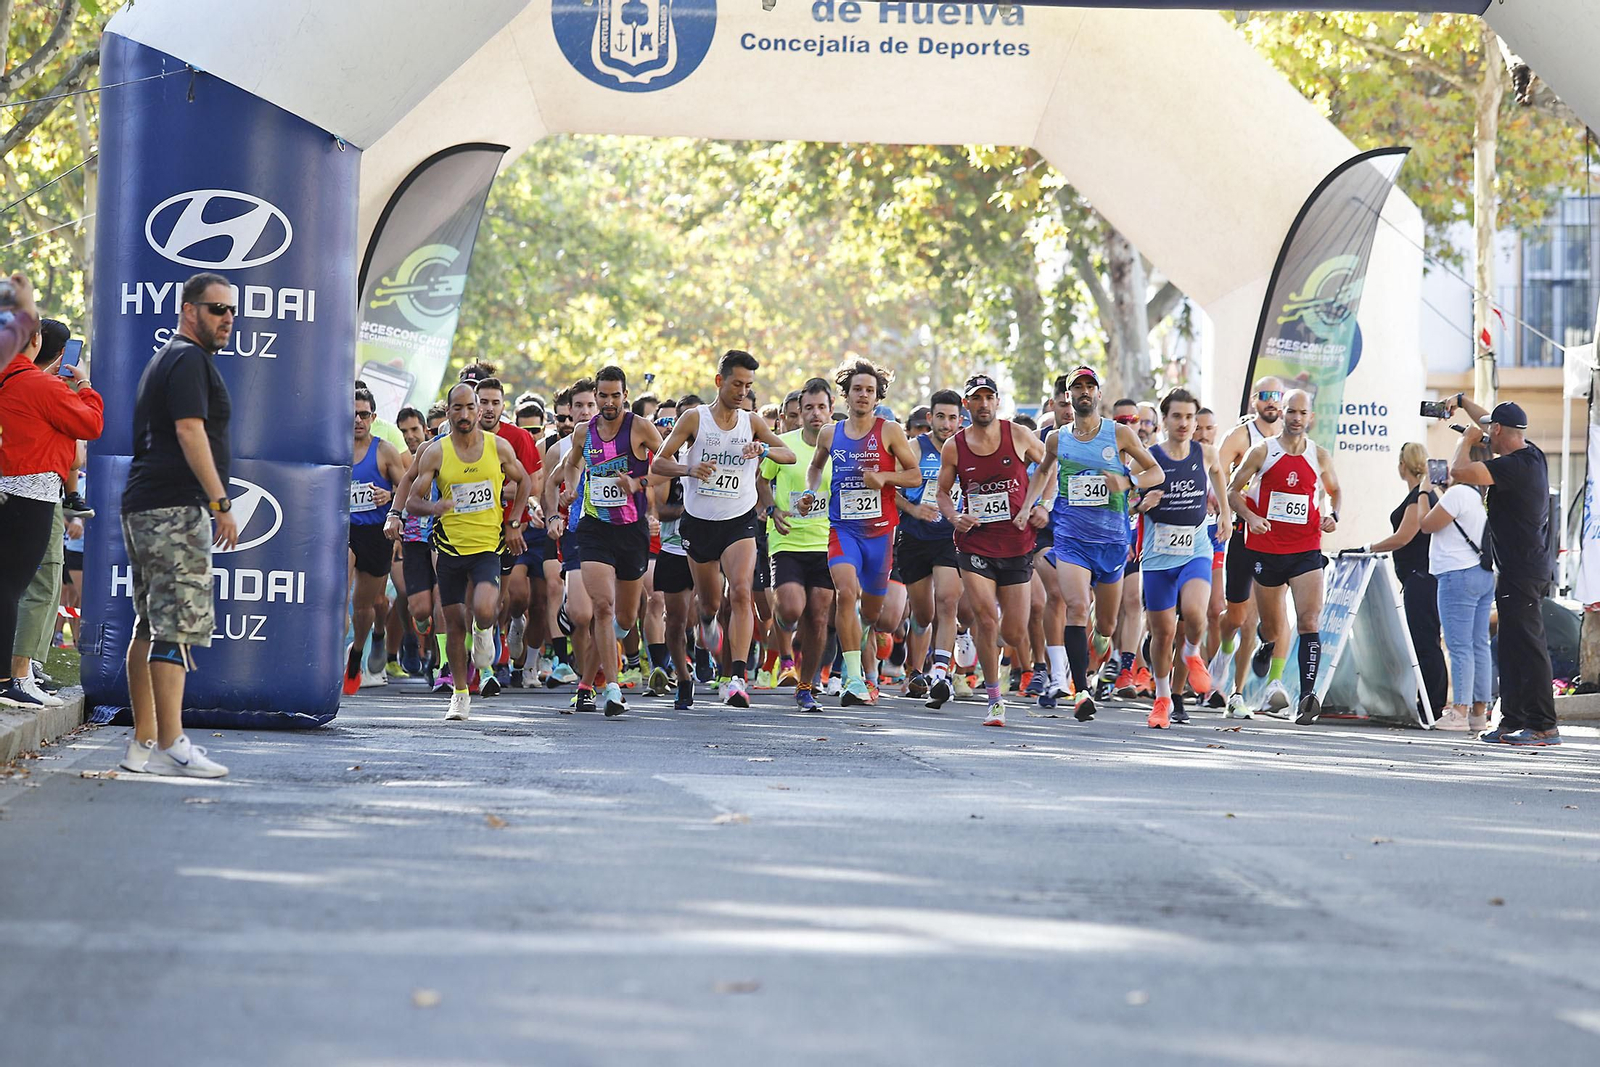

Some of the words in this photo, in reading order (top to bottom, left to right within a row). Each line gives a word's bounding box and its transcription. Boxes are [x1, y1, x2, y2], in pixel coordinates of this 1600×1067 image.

[812, 0, 862, 23] de
[878, 2, 1025, 25] Huelva
[740, 33, 870, 56] Concejalía
[880, 36, 909, 54] de
[918, 37, 1030, 59] Deportes
[121, 282, 315, 322] HYDAI
[1339, 440, 1391, 453] Deportes
[701, 449, 746, 466] bathco
[716, 475, 739, 490] 470
[980, 478, 1020, 492] COSTA
[1170, 479, 1196, 492] HGC
[352, 490, 373, 504] 173
[469, 488, 492, 504] 239
[1084, 484, 1108, 498] 340
[856, 497, 878, 511] 321
[984, 500, 1008, 514] 454
[1286, 502, 1307, 516] 659
[1170, 533, 1193, 547] 240
[111, 565, 305, 604] HNDAI
